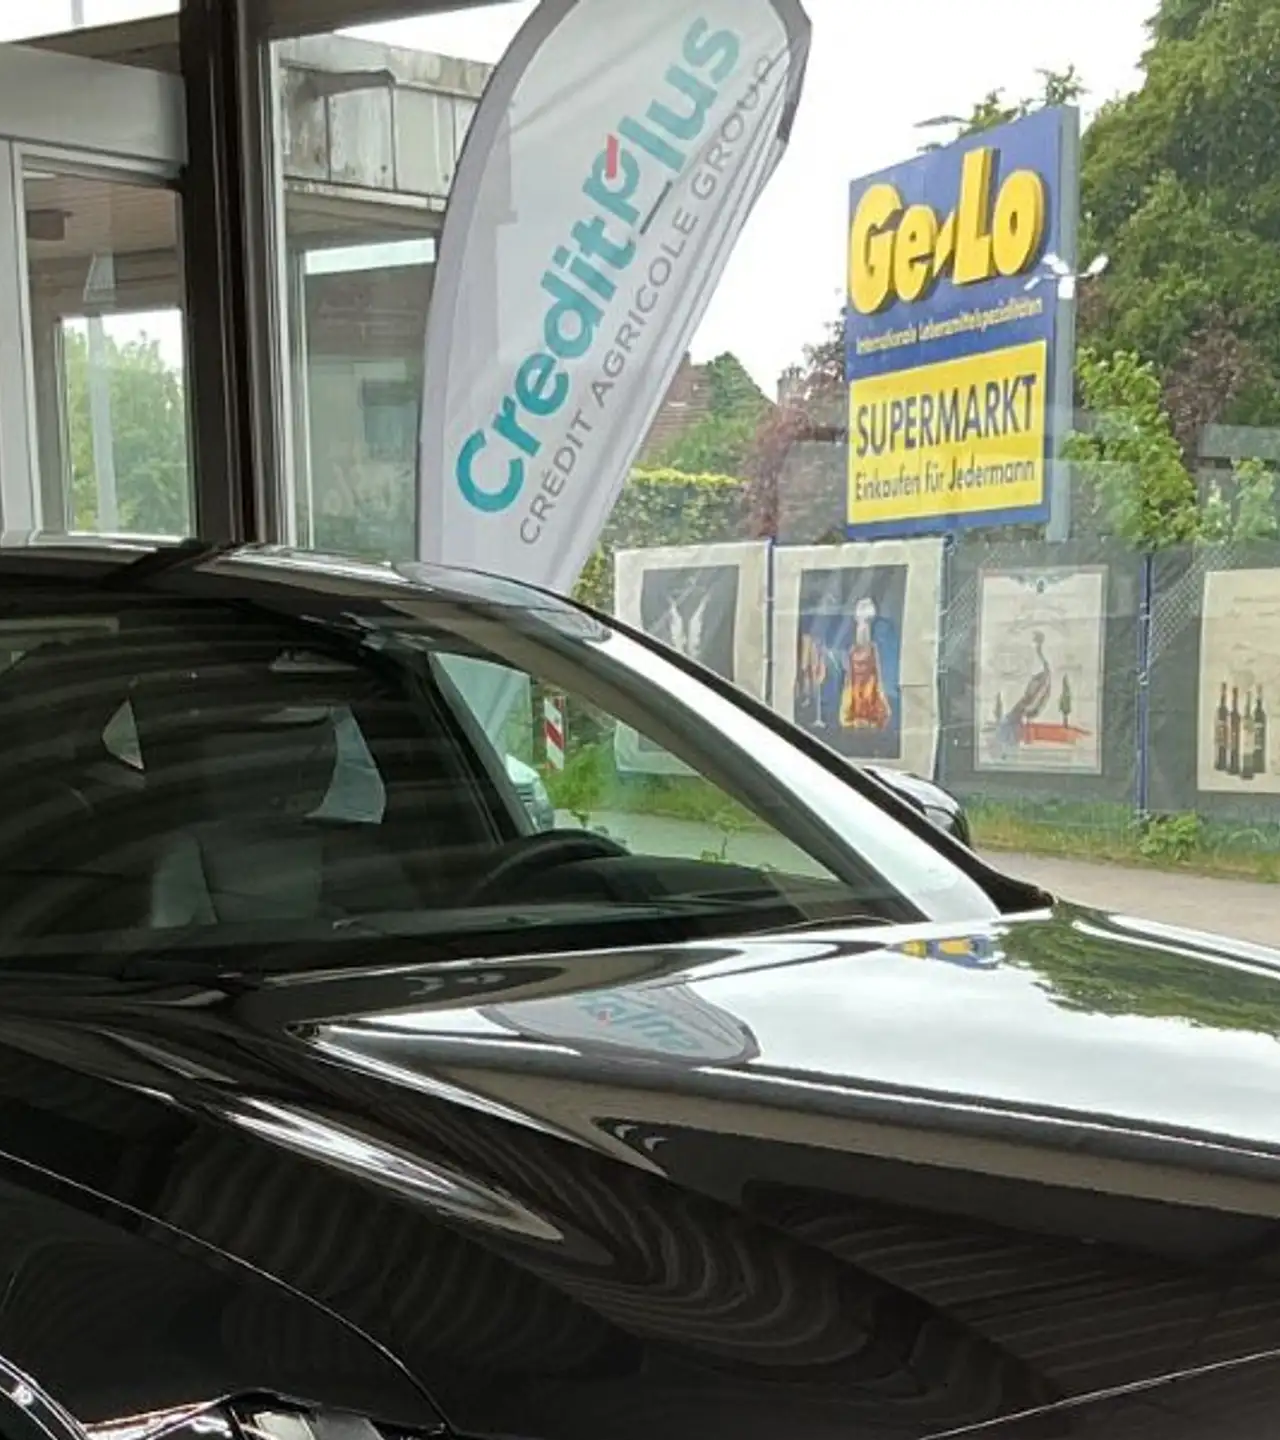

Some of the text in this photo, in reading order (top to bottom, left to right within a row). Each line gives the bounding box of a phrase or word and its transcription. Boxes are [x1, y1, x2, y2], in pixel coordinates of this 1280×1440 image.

[456, 17, 741, 513] Creditplus
[520, 52, 773, 546] CRÉDIT AGRICOLE GROUP
[856, 373, 1037, 458] SUPERMARKT
[856, 453, 1035, 502] Einkaufen für Jedermann
